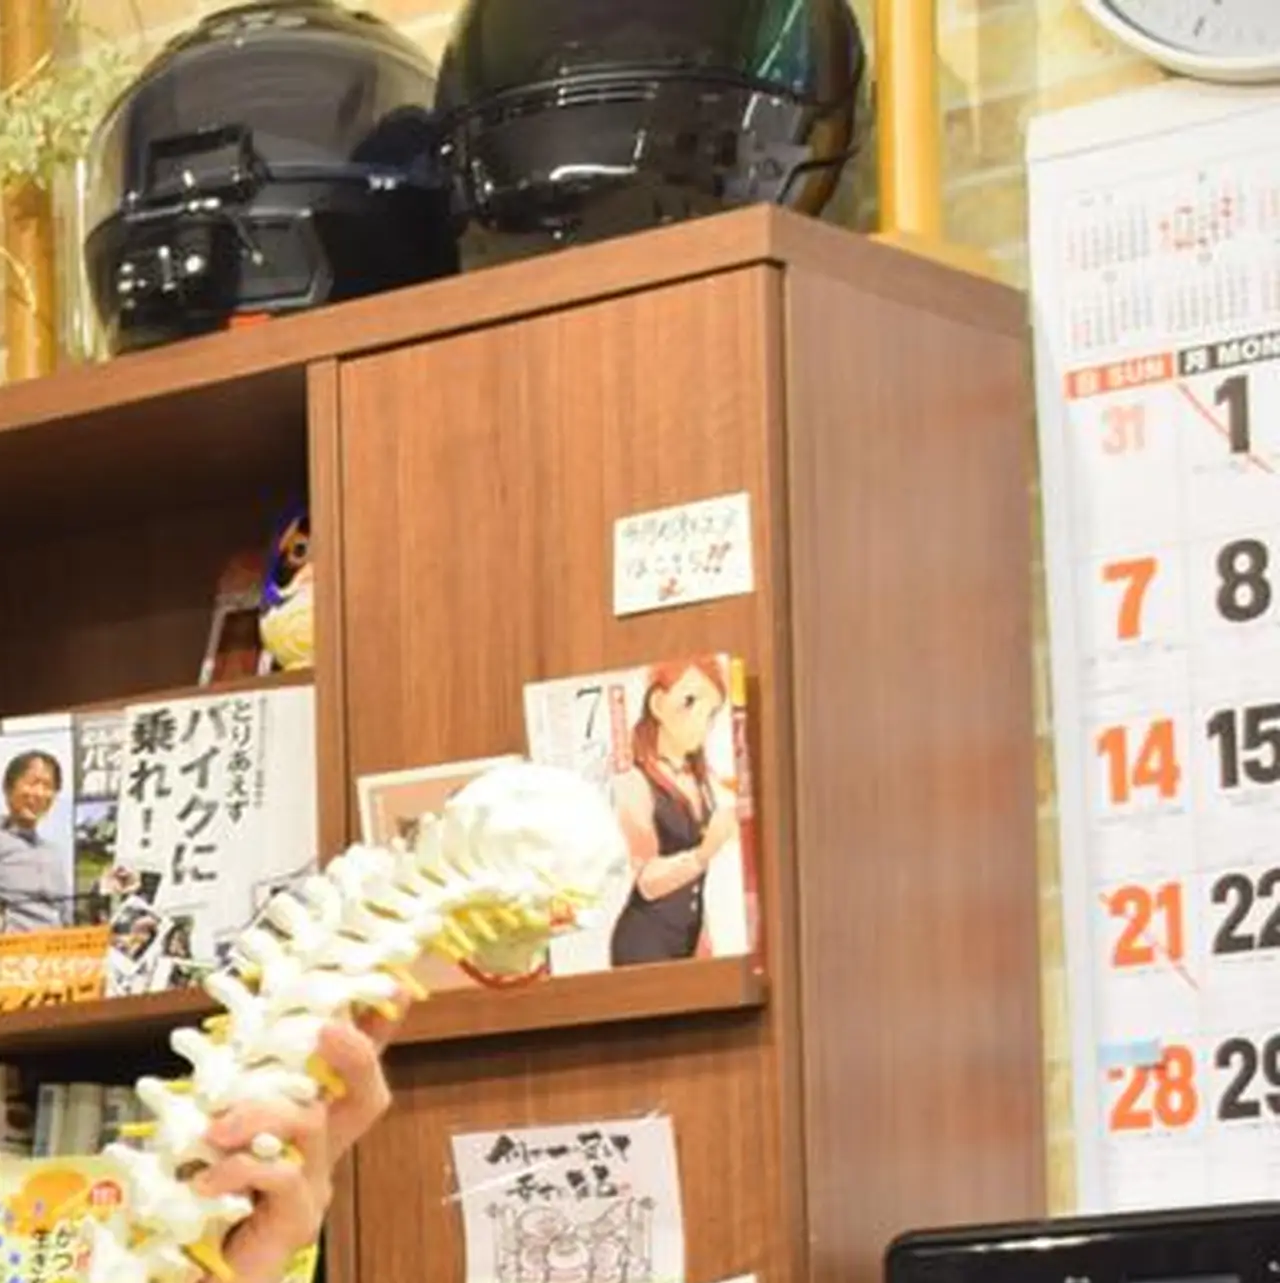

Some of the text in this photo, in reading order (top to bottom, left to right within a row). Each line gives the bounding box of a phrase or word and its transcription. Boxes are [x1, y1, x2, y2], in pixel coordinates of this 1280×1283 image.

[1101, 374, 1251, 456] 31 1
[1109, 356, 1168, 390] SUN
[1102, 538, 1273, 640] 7 8
[171, 700, 230, 886] バイクに
[1096, 703, 1280, 805] 14 15
[1103, 881, 1184, 968] 21
[1108, 1043, 1197, 1133] 28
